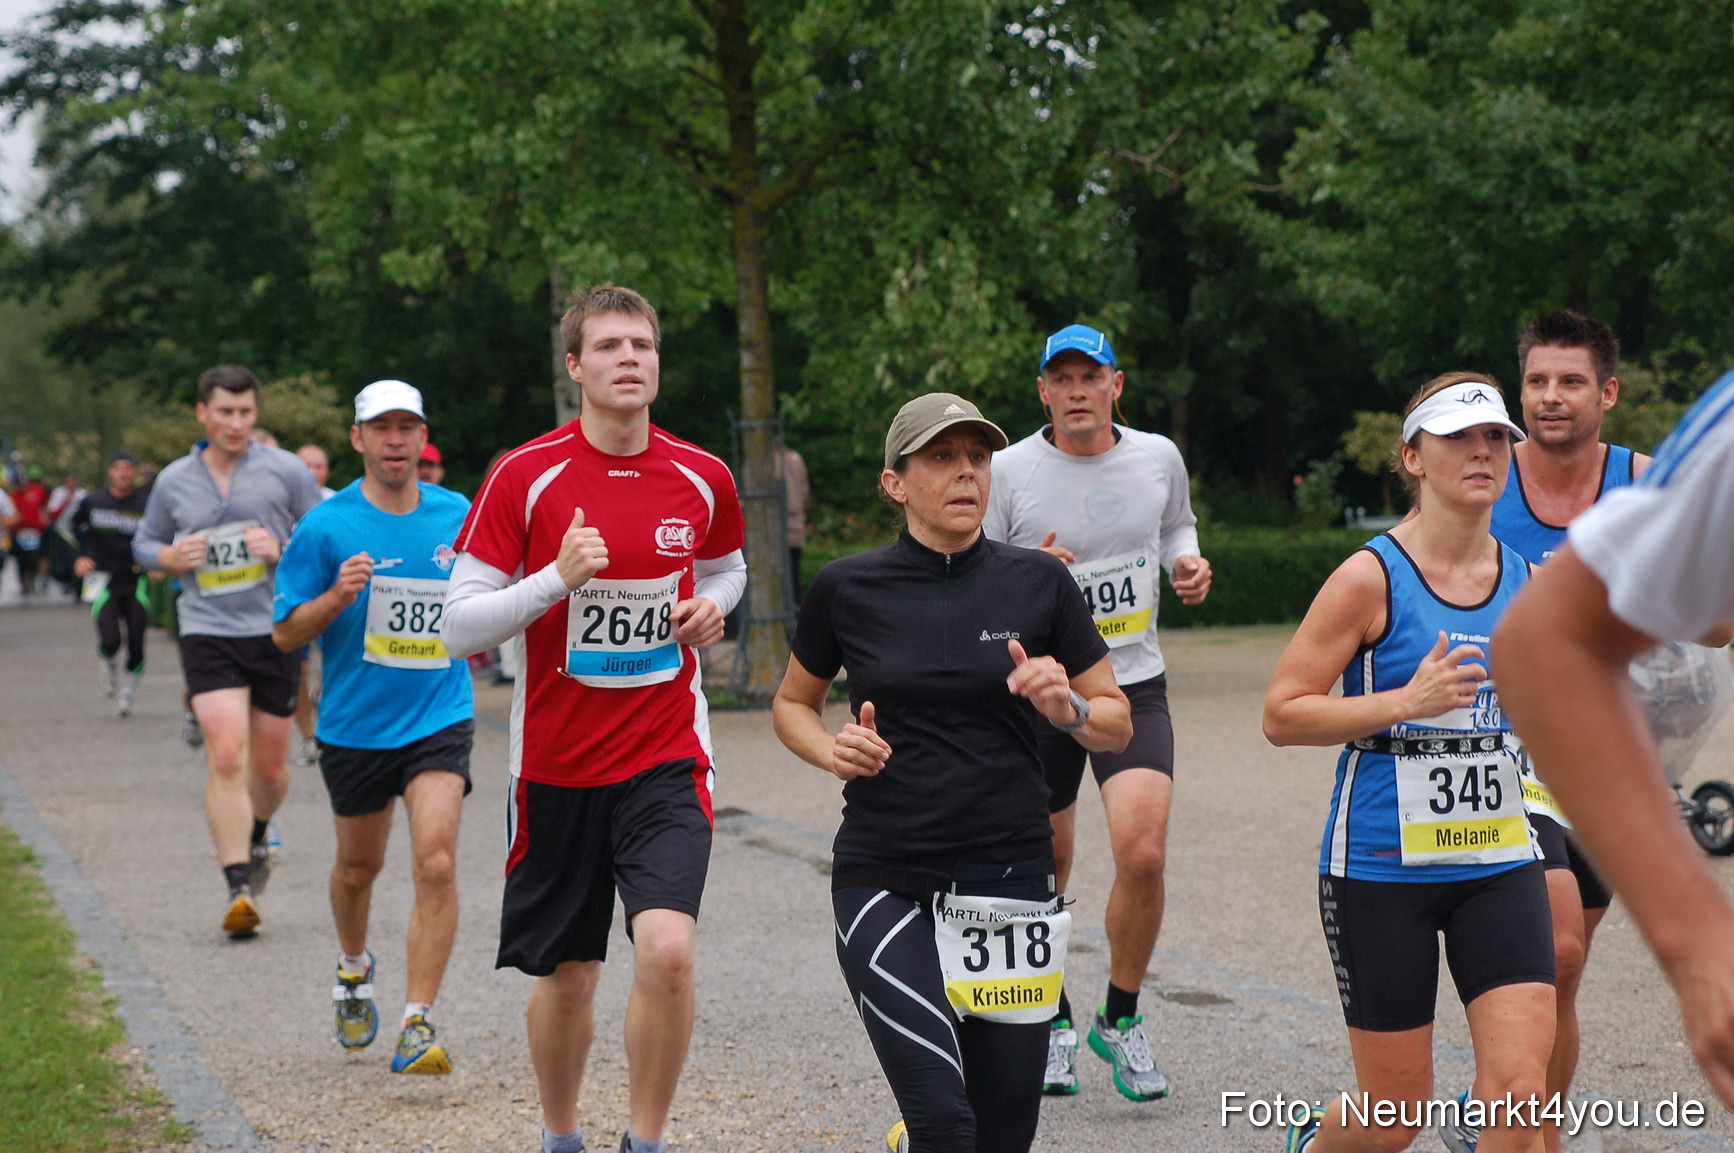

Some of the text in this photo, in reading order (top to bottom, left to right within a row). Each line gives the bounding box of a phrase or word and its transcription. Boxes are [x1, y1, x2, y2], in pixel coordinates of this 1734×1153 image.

[607, 469, 635, 478] CRAFT
[207, 541, 249, 568] 424
[1090, 562, 1134, 580] Neumarkt
[372, 584, 404, 597] PARTL
[573, 587, 668, 601] PARTL Neumarkt
[1083, 576, 1137, 616] 494
[388, 601, 443, 634] 382
[581, 601, 672, 646] 2648
[389, 640, 436, 656] Gerhard
[601, 656, 652, 675] Jürgen
[1428, 763, 1503, 814] 345
[1436, 825, 1500, 847] Melanie
[937, 906, 985, 923] PARTL
[961, 920, 1052, 973] 318
[1322, 879, 1351, 1008] skinfit
[972, 985, 1044, 1007] Kristina
